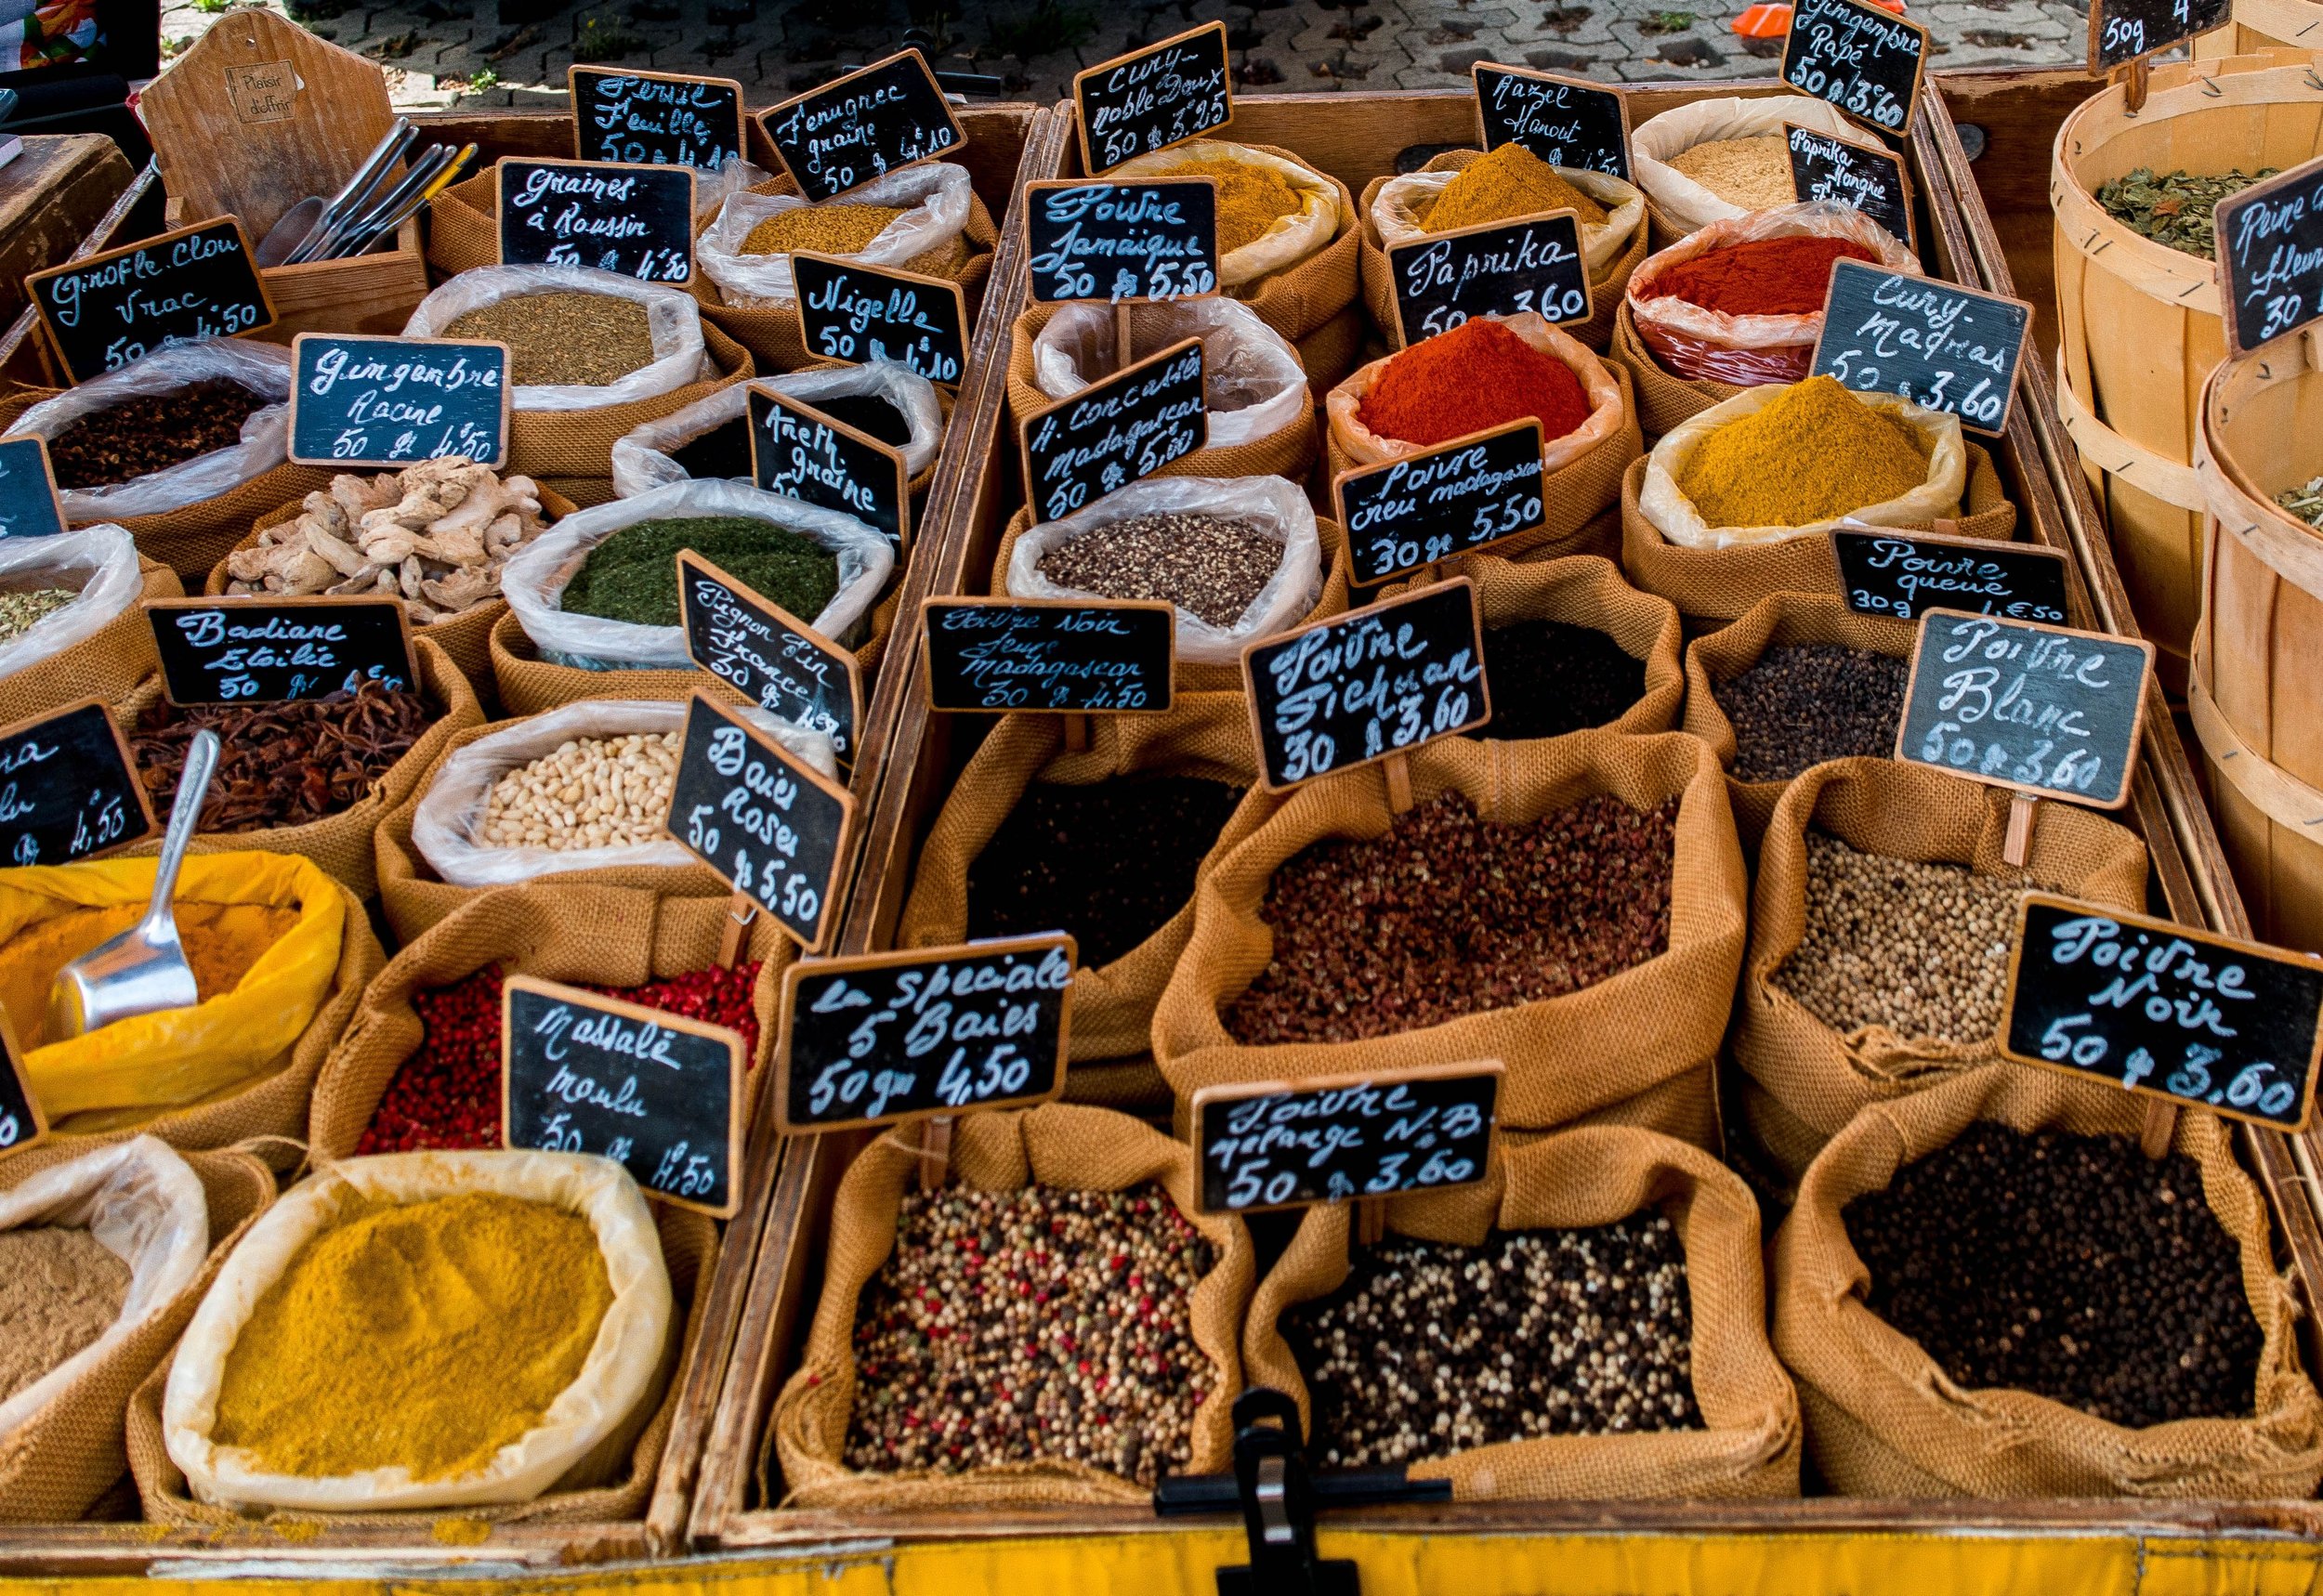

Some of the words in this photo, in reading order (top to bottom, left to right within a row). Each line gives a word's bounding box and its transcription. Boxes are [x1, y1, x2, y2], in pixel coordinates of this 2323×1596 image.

[243, 74, 282, 90] Plaisir
[1790, 55, 1827, 93] 50
[250, 94, 291, 115] d'offrir
[777, 85, 907, 148] Fenugrec
[808, 123, 876, 175] graine
[1104, 128, 1138, 166] 50
[1790, 128, 1857, 167] Paprika
[824, 165, 855, 194] 50
[1044, 184, 1186, 225] Poivre
[1030, 221, 1204, 273] Jamaïque
[1406, 229, 1578, 303] Paprika
[807, 274, 944, 334] Nigelle
[1053, 261, 1096, 299] 50
[1148, 260, 1215, 303] 5,50
[819, 325, 856, 358] 50
[1421, 305, 1467, 341] 50
[1855, 309, 2006, 373] Madras
[2260, 293, 2303, 340] 30
[104, 335, 147, 373] 50
[309, 347, 499, 396] Gingembre
[1828, 349, 1881, 390] 50
[346, 388, 443, 427] Racine
[332, 426, 369, 459] 50
[765, 403, 847, 475] Aneth
[791, 445, 877, 512] graine
[1379, 446, 1490, 500] Poivre
[1045, 477, 1087, 520] 50
[1370, 537, 1420, 576] 30
[1467, 492, 1542, 542] 5,50
[1867, 539, 2009, 581] Poivre
[175, 610, 348, 648] Badiane
[1054, 610, 1131, 635] Noir
[708, 646, 750, 687] 30
[1268, 617, 1429, 697] Poivre
[1942, 618, 2110, 688] Poivre
[218, 673, 260, 700] 50
[981, 678, 1030, 708] 30
[1937, 666, 2091, 737] Blanc
[1280, 727, 1336, 782] 30
[1391, 685, 1470, 747] 3,60
[1921, 720, 1976, 766] 50
[706, 726, 798, 811] Baies
[721, 786, 800, 858] Roses
[688, 803, 721, 855] 50
[758, 858, 820, 922] 5,50
[2051, 917, 2257, 1001] Poivre
[847, 1009, 899, 1059] 5
[903, 998, 1041, 1058] Baies
[2087, 972, 2239, 1039] Noir
[2041, 1013, 2109, 1067] 50
[935, 1043, 1031, 1107] 4,50
[1227, 1081, 1418, 1135] Poivre
[1225, 1158, 1298, 1209] 50
[1363, 1147, 1476, 1196] 3,60
